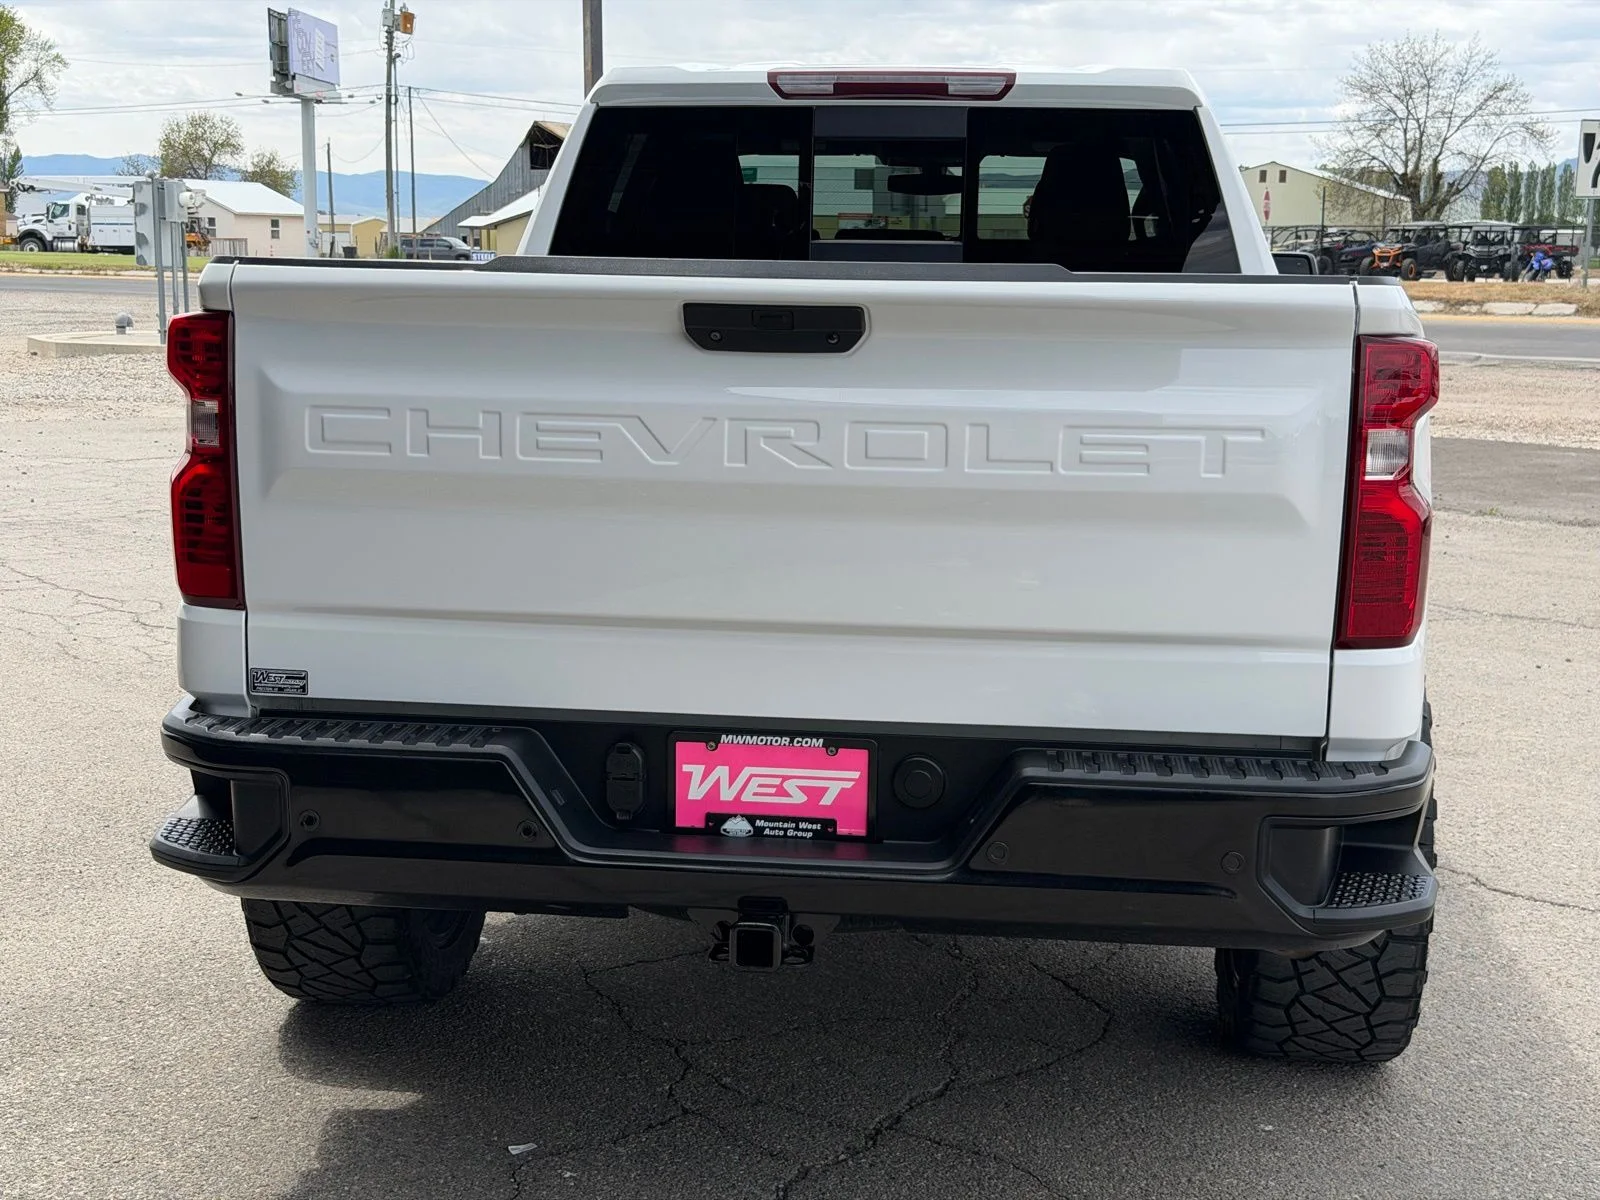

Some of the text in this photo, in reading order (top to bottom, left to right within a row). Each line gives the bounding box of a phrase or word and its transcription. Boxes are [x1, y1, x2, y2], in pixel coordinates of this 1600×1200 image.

[304, 405, 1266, 479] CHEVROLET
[720, 734, 824, 748] MWMOTOR.COM
[682, 764, 861, 805] WEST
[755, 819, 822, 830] Mountain West
[763, 828, 813, 839] Auto Group
